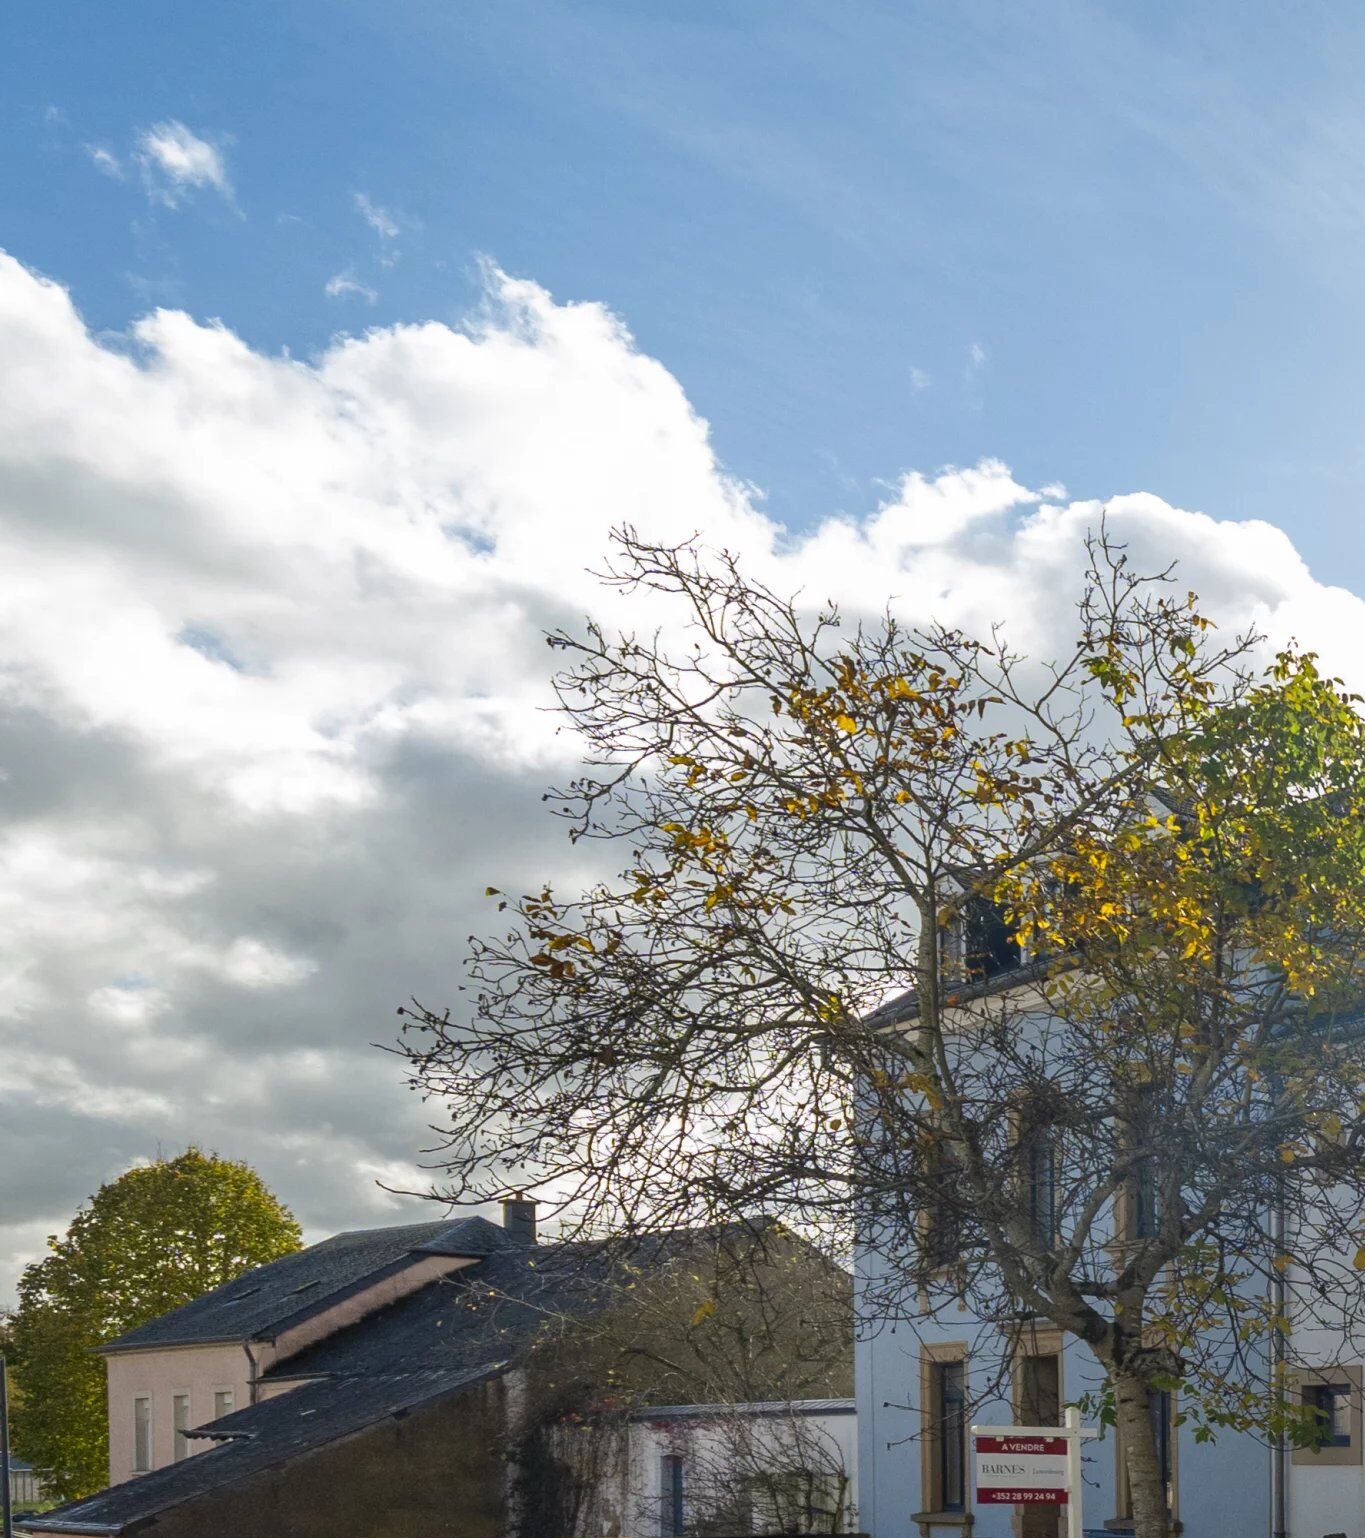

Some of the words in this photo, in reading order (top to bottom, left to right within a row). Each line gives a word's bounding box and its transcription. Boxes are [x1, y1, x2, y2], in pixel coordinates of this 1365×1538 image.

[1001, 1443, 1009, 1451] A
[1009, 1443, 1045, 1452] VENDRE
[981, 1464, 1025, 1474] BARNES
[992, 1492, 1010, 1500] +352
[1012, 1492, 1022, 1500] 28
[1023, 1492, 1033, 1500] 99
[1034, 1492, 1044, 1500] 24
[1045, 1492, 1056, 1500] 94
